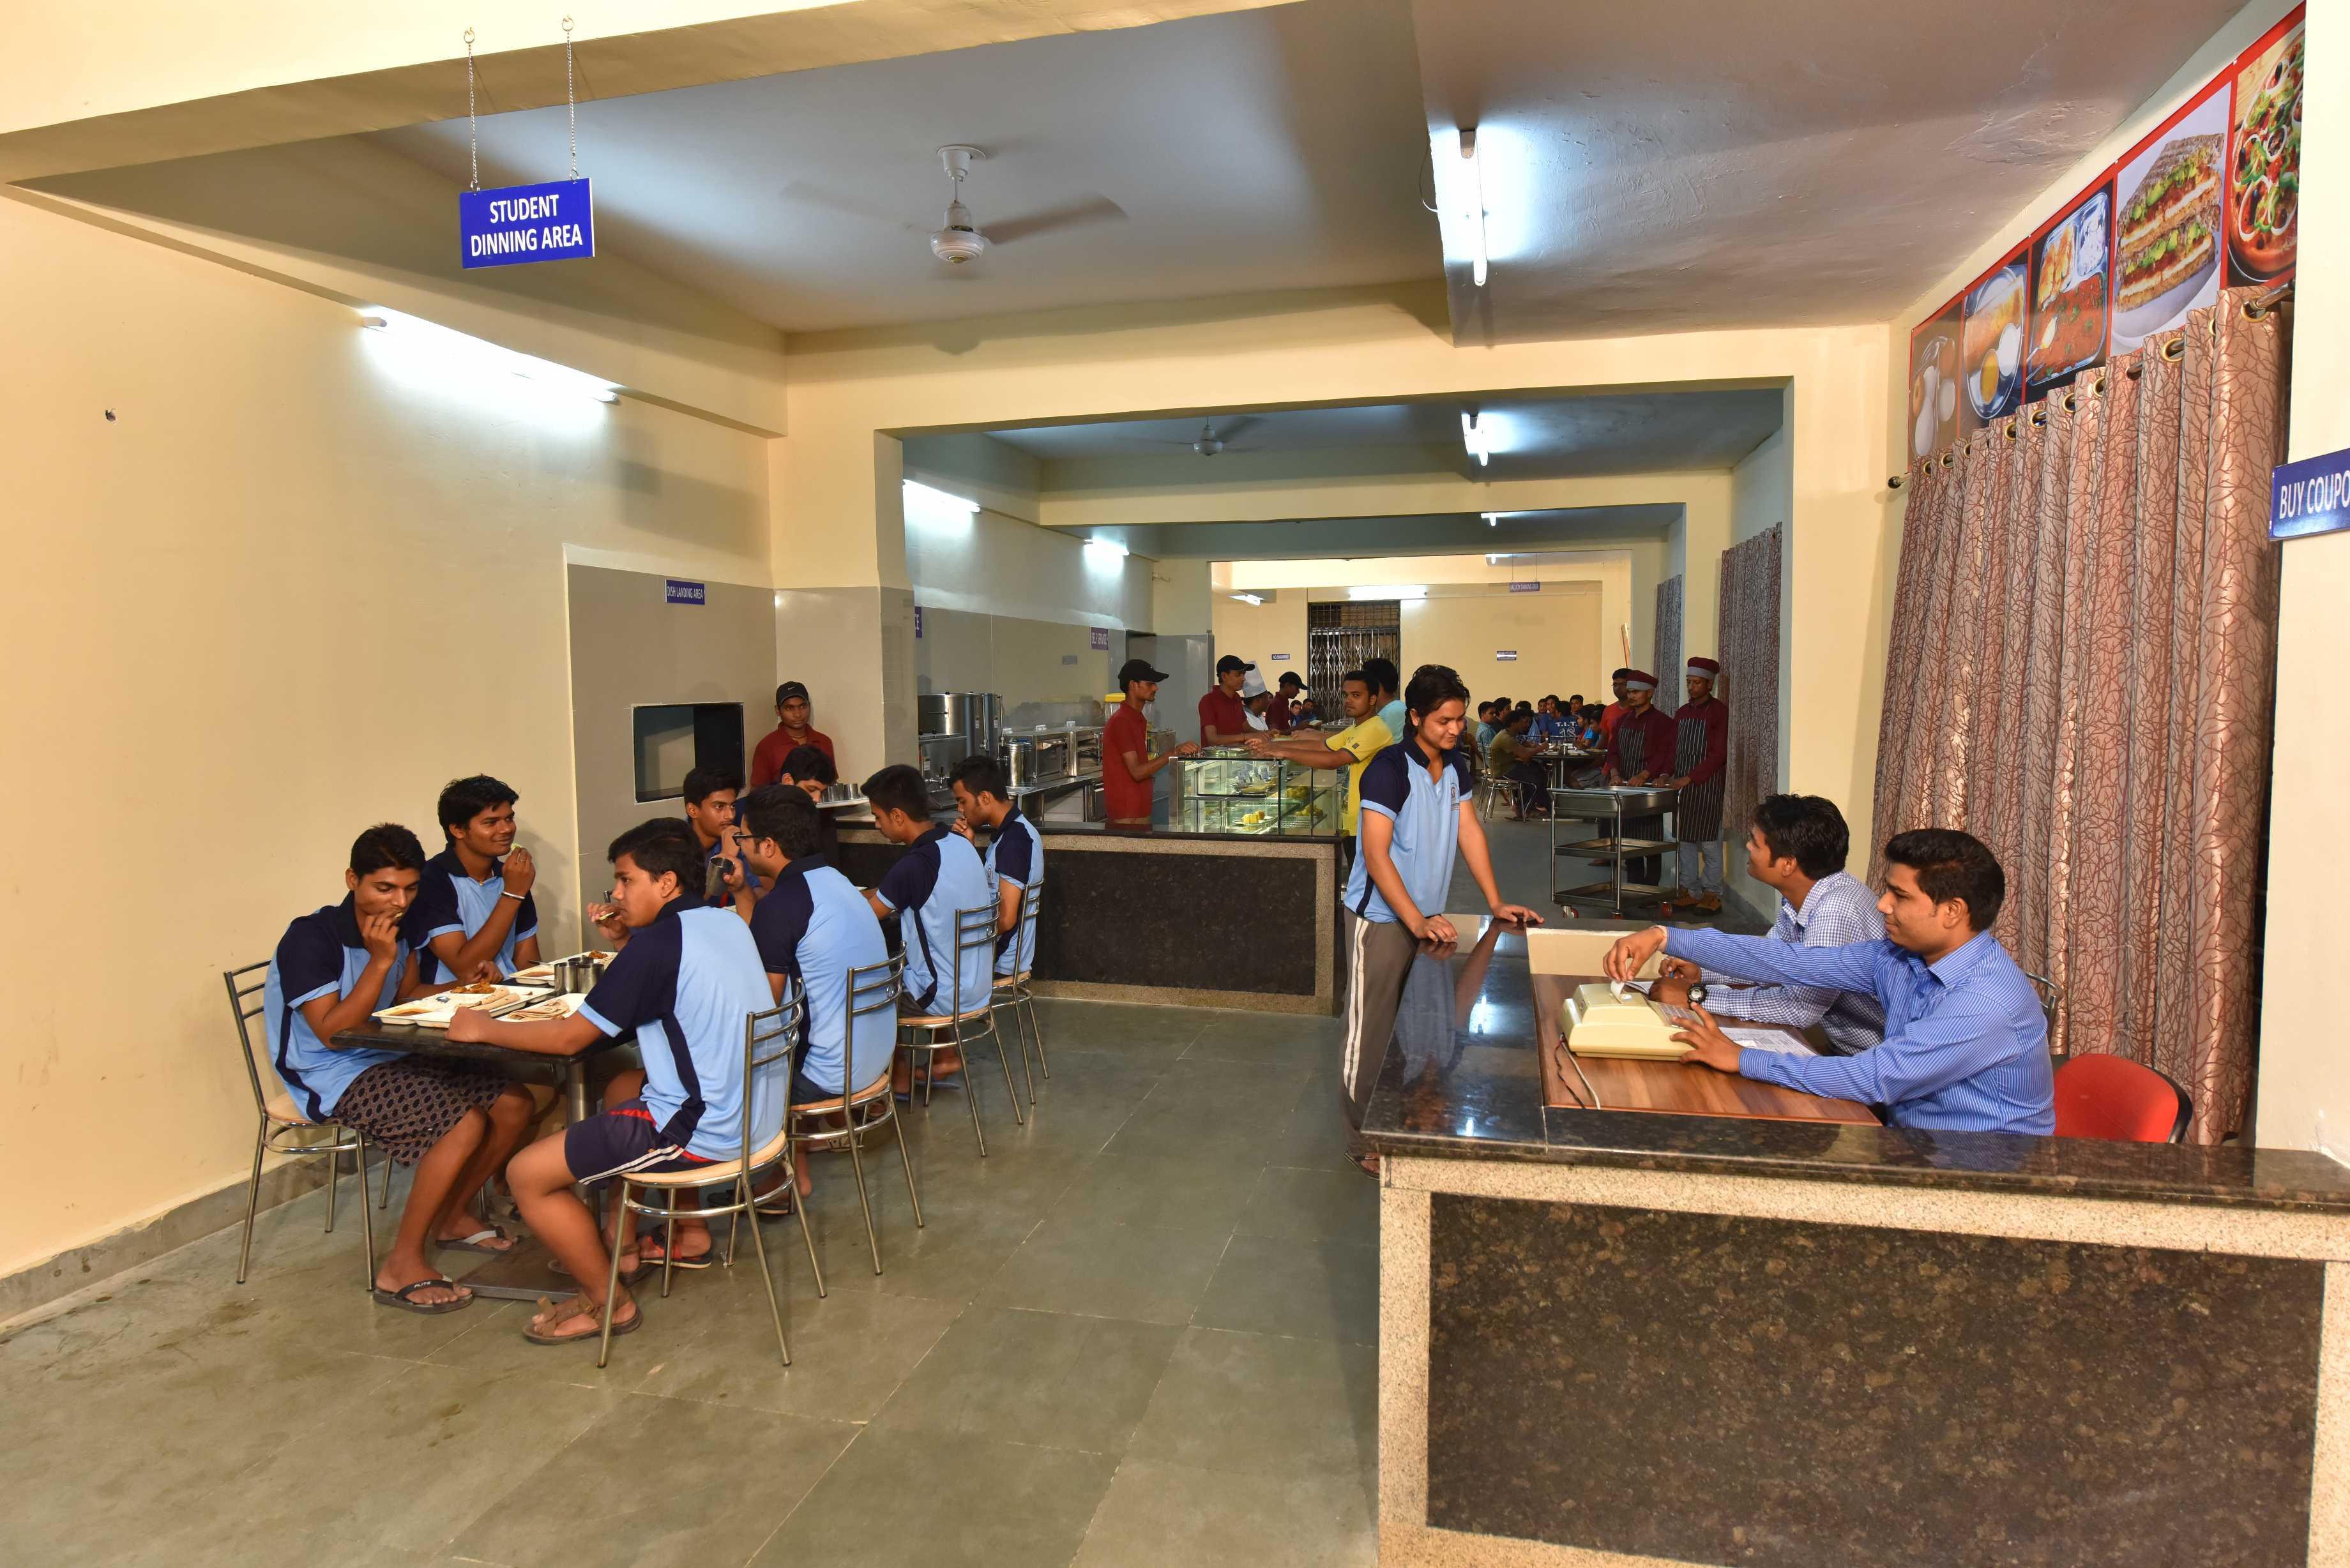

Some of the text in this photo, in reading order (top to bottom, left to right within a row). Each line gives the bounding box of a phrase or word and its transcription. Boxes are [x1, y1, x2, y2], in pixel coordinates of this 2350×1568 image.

[490, 194, 559, 223] STUDENT
[471, 224, 582, 257] DINNING AREA
[2279, 481, 2305, 519] BUY
[667, 586, 703, 599] DISH LANDING AREA
